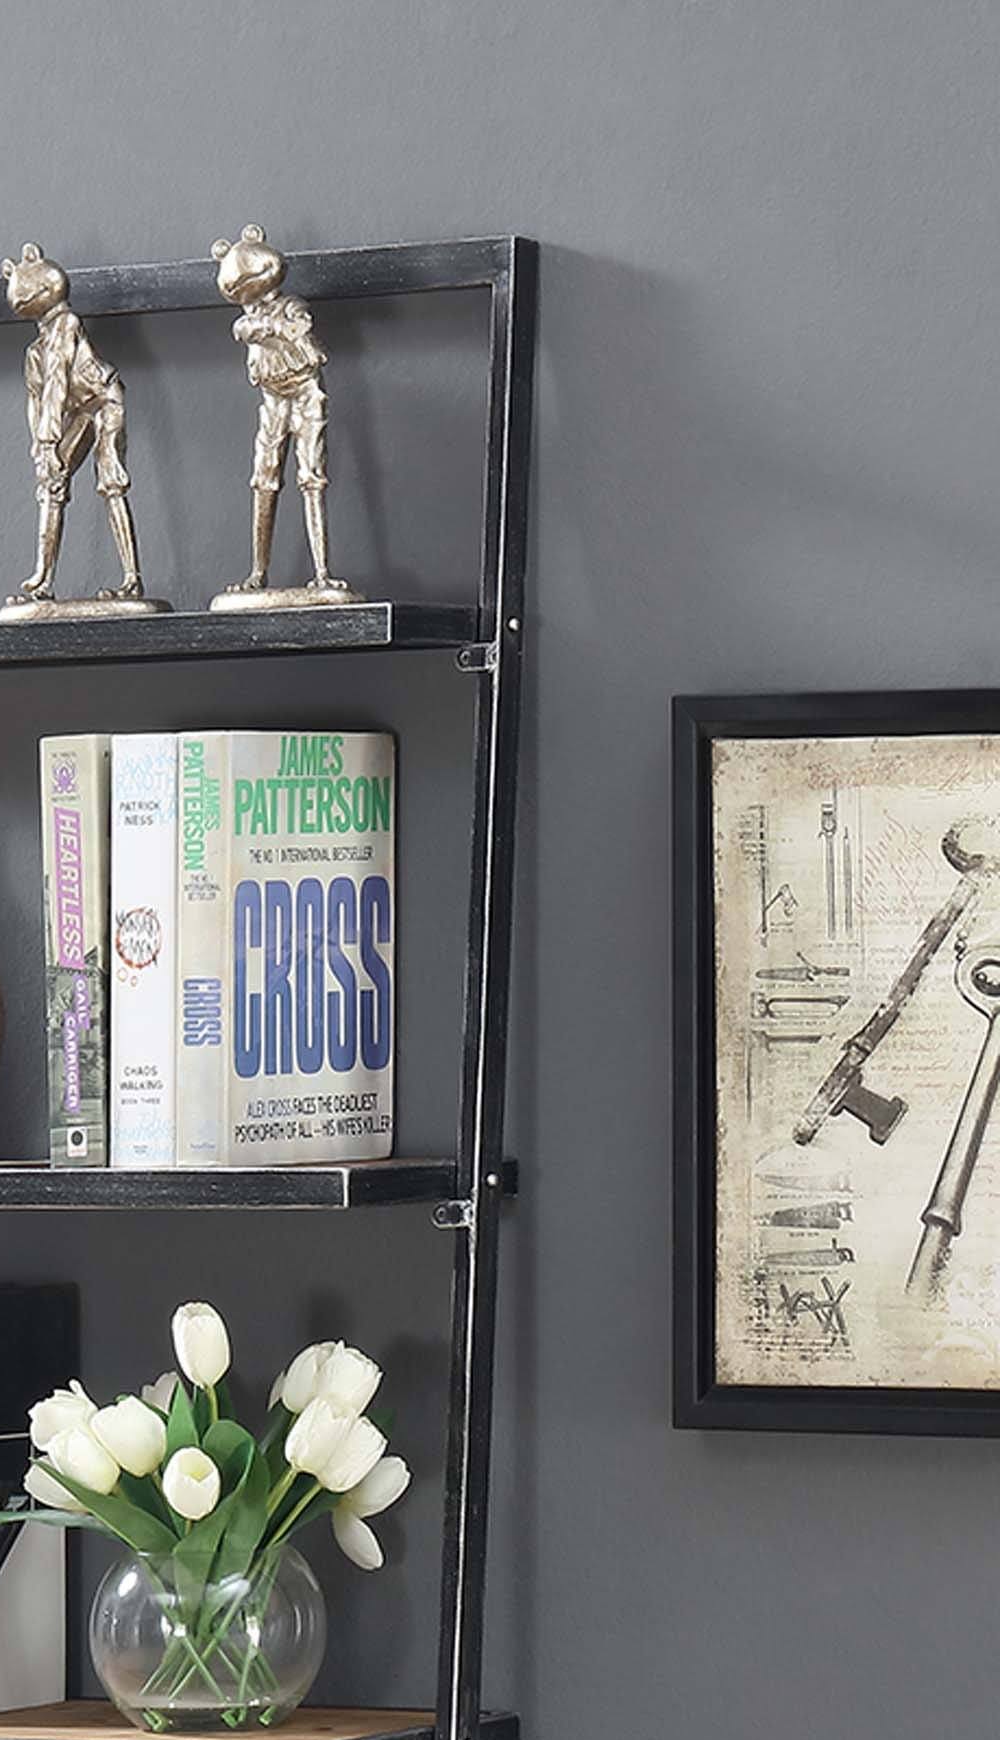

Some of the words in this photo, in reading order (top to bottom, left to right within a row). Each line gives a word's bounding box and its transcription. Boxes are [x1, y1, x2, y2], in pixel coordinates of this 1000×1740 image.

[277, 735, 345, 777] JAMES
[119, 801, 160, 812] PATRICK
[124, 815, 154, 826] NESS
[182, 740, 205, 872] PATTERSON
[204, 778, 221, 831] JAMES
[234, 775, 391, 836] PATTERSON
[59, 813, 81, 962] HEARTLESS
[75, 979, 87, 1023] GAIL
[234, 875, 391, 1079] CROSS
[183, 978, 222, 1047] CROSS
[65, 1015, 79, 1108] CARRIGER
[119, 1079, 164, 1091] WALKING
[123, 1065, 159, 1077] CHAOS
